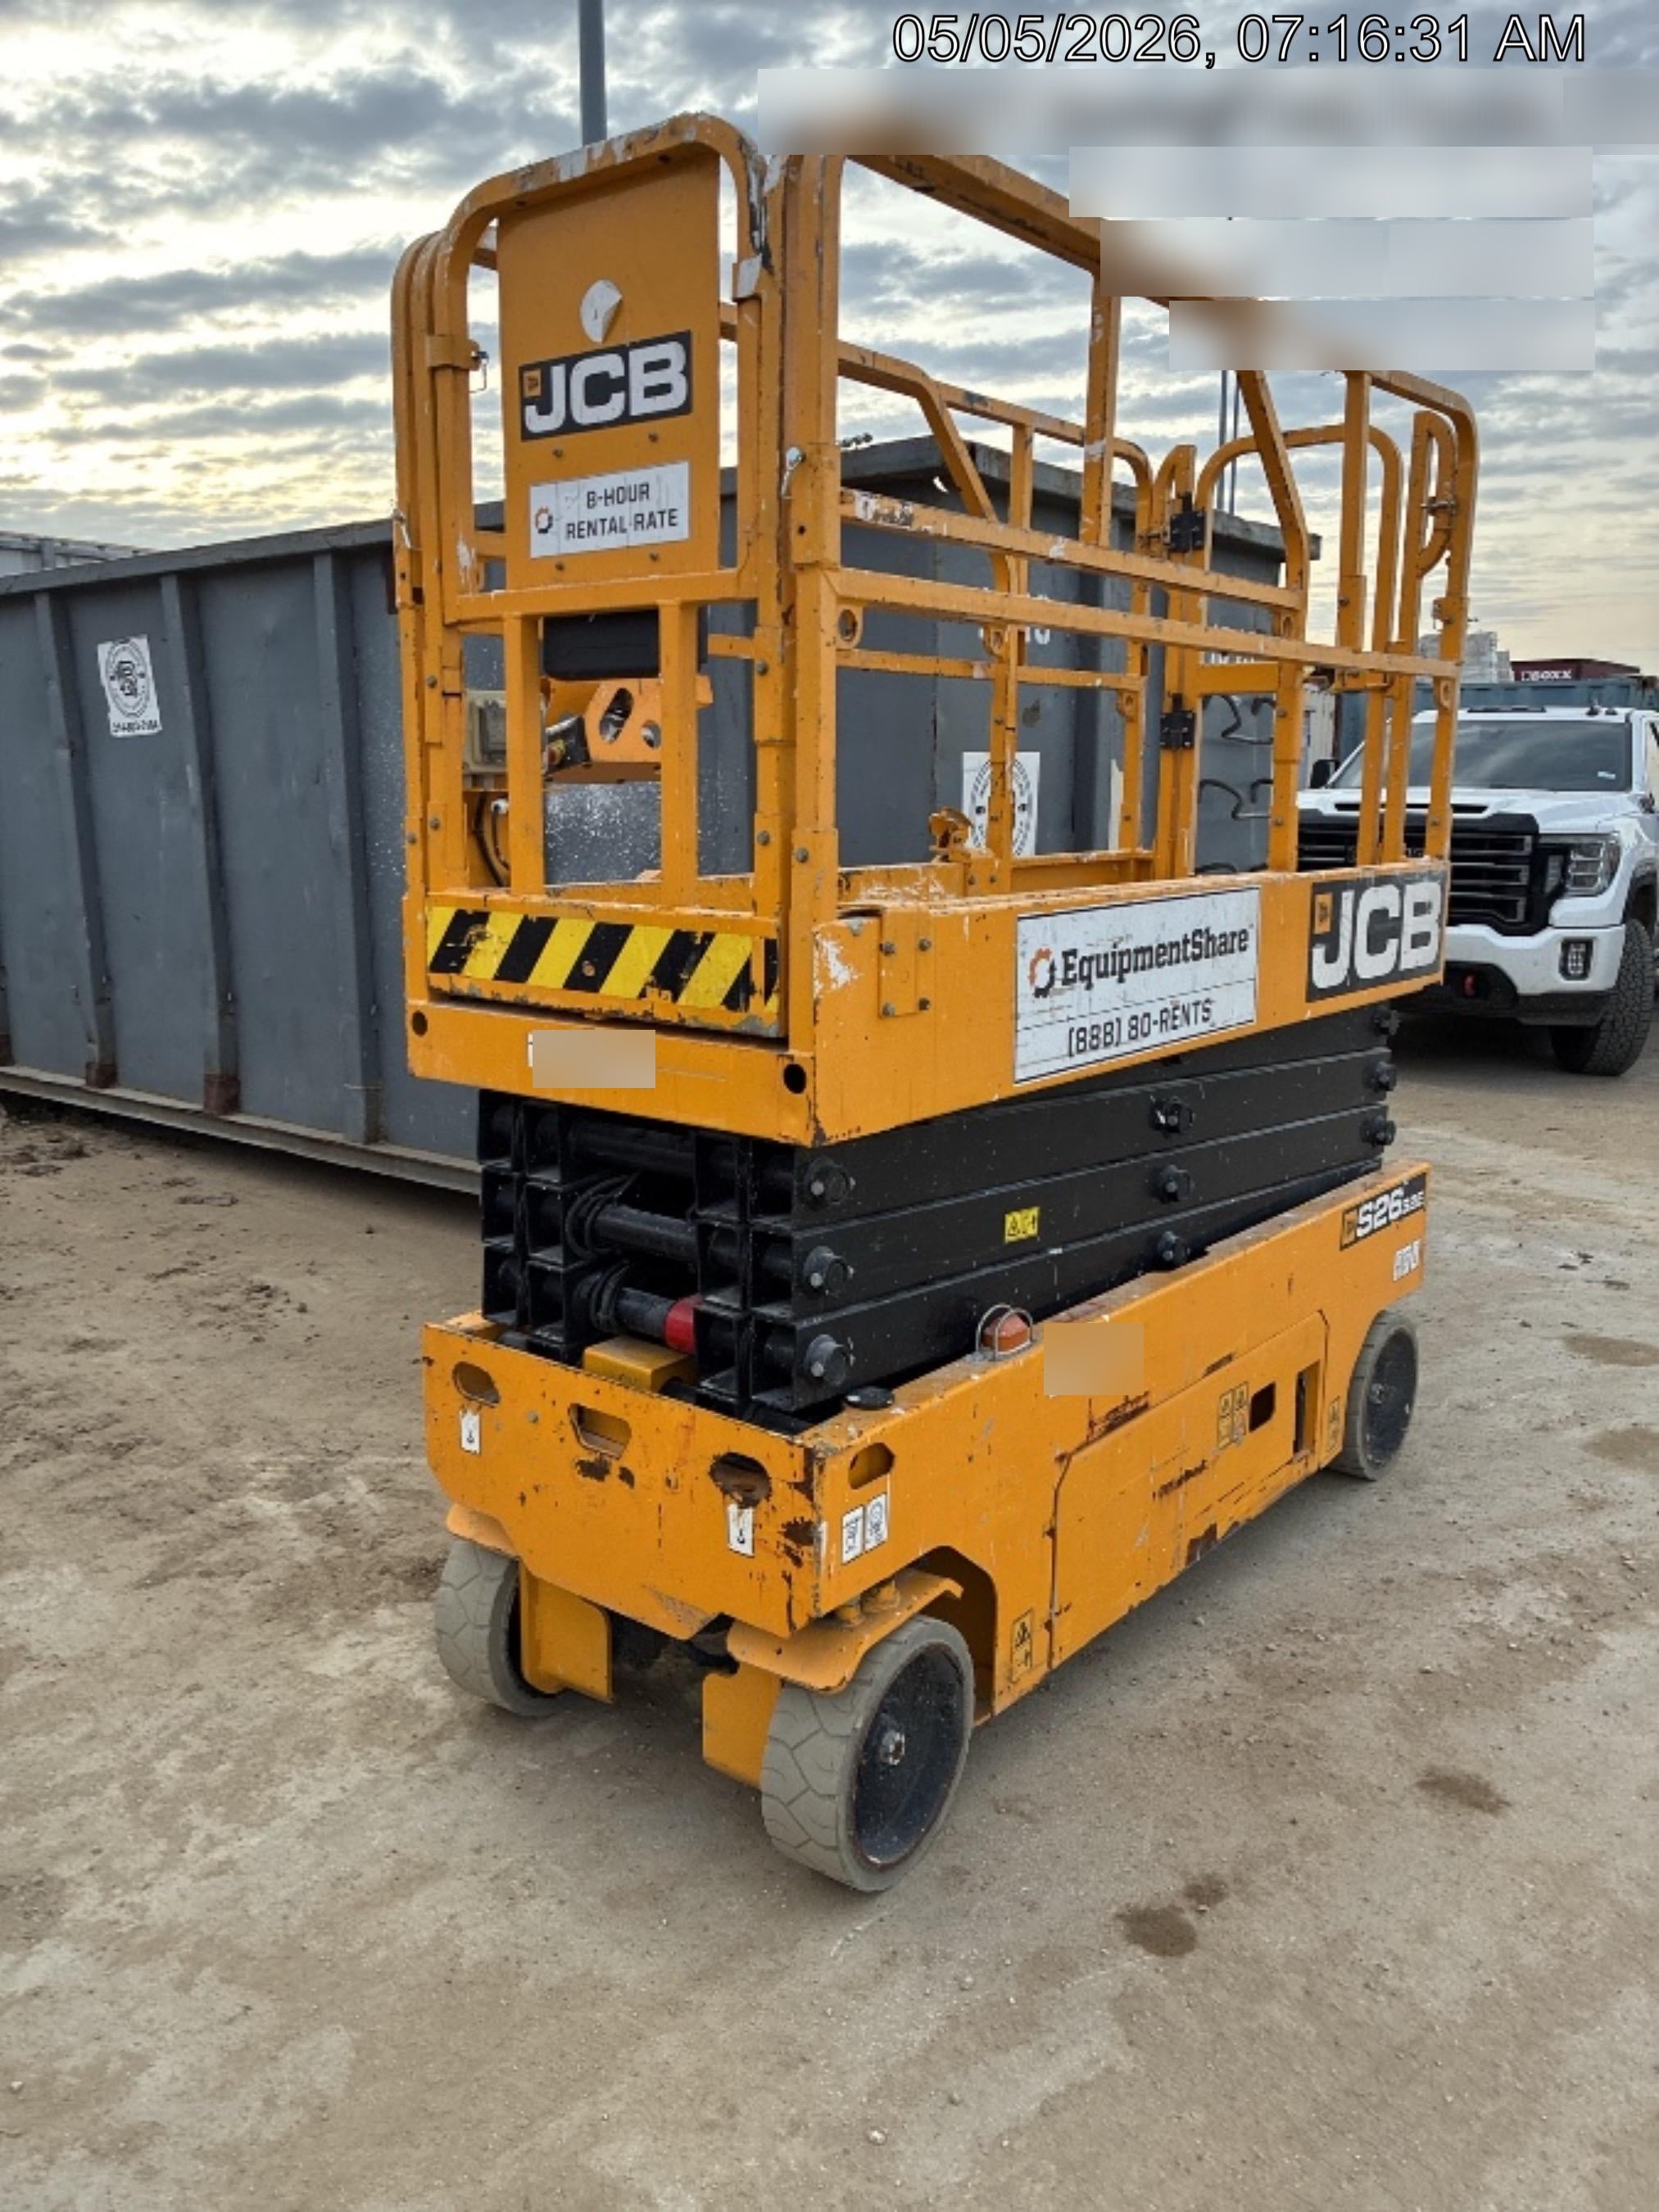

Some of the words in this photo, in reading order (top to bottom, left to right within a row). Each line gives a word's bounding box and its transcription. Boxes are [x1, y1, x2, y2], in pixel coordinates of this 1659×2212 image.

[524, 341, 687, 433] JCB
[587, 482, 650, 509] 8-HOUR
[566, 516, 627, 540] RENTAL
[633, 508, 678, 531] RATE
[1062, 927, 1249, 990] EquipmentShare
[1312, 881, 1442, 988] JCB
[1128, 998, 1213, 1040] 80-RENTS
